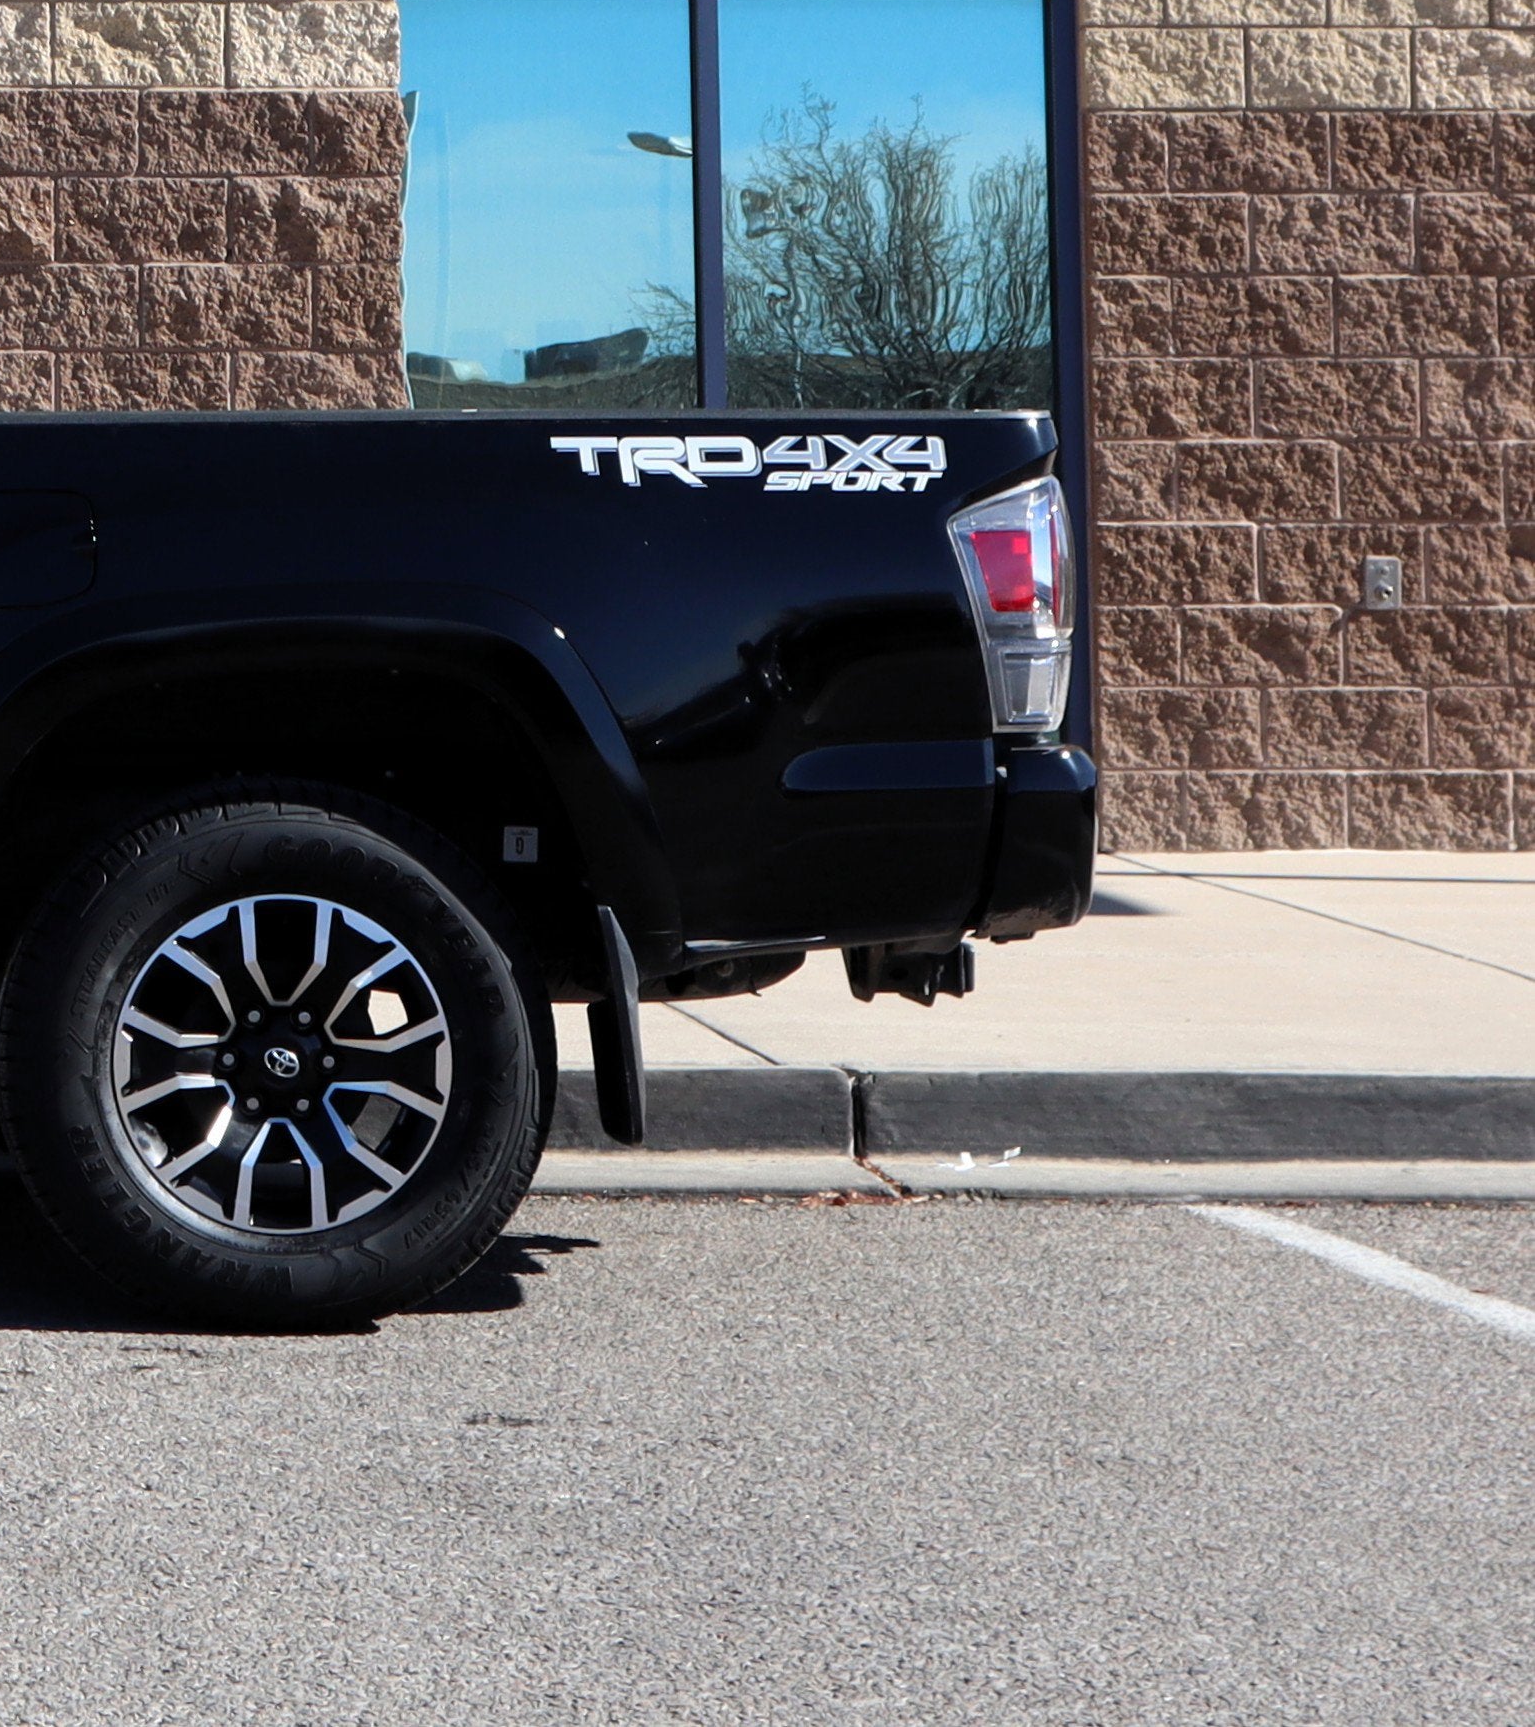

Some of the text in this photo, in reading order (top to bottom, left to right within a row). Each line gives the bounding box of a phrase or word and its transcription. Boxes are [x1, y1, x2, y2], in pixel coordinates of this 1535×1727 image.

[550, 434, 948, 488] TRD 4X4
[763, 471, 944, 492] SPORT
